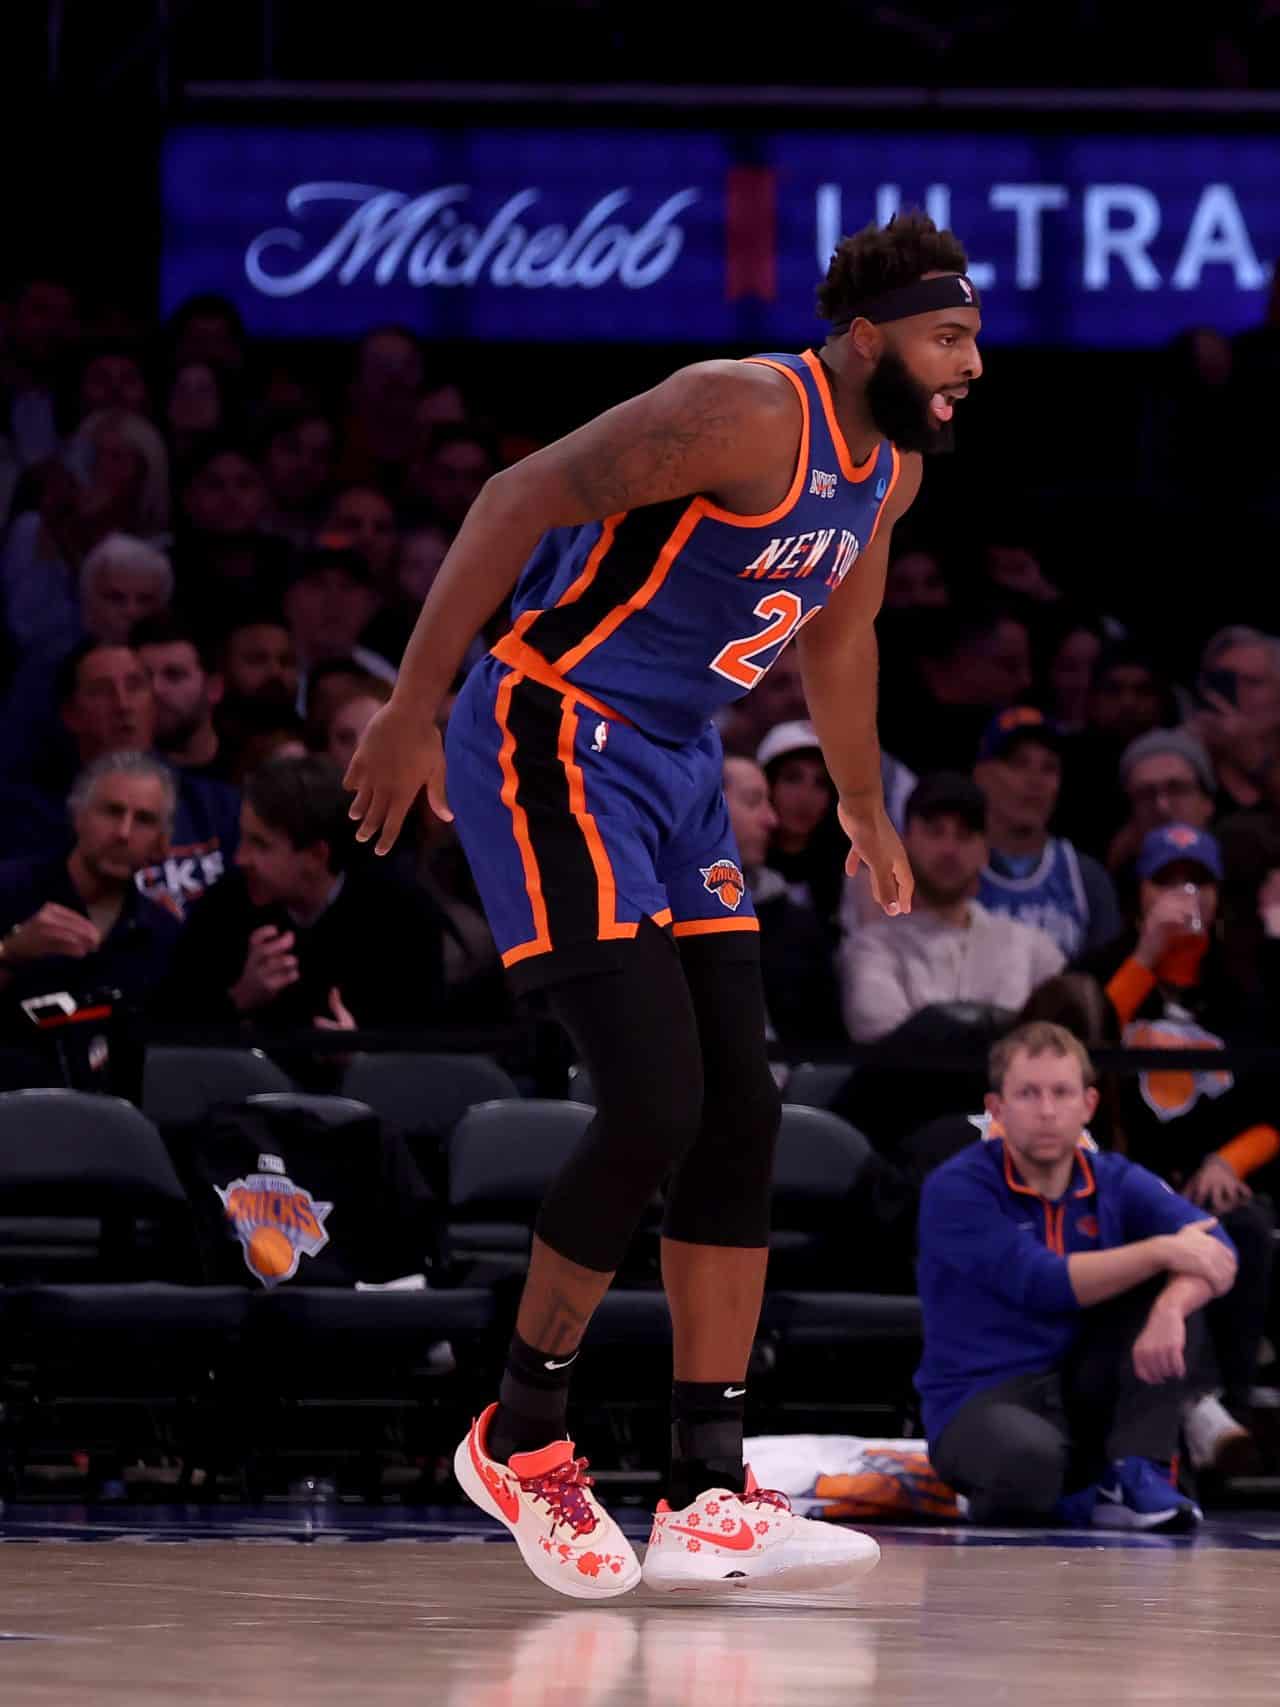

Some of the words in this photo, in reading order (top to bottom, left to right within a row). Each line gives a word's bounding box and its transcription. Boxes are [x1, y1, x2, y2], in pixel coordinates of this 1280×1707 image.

[245, 181, 701, 297] Michelob
[738, 528, 836, 580] NEW
[708, 589, 823, 690] 2
